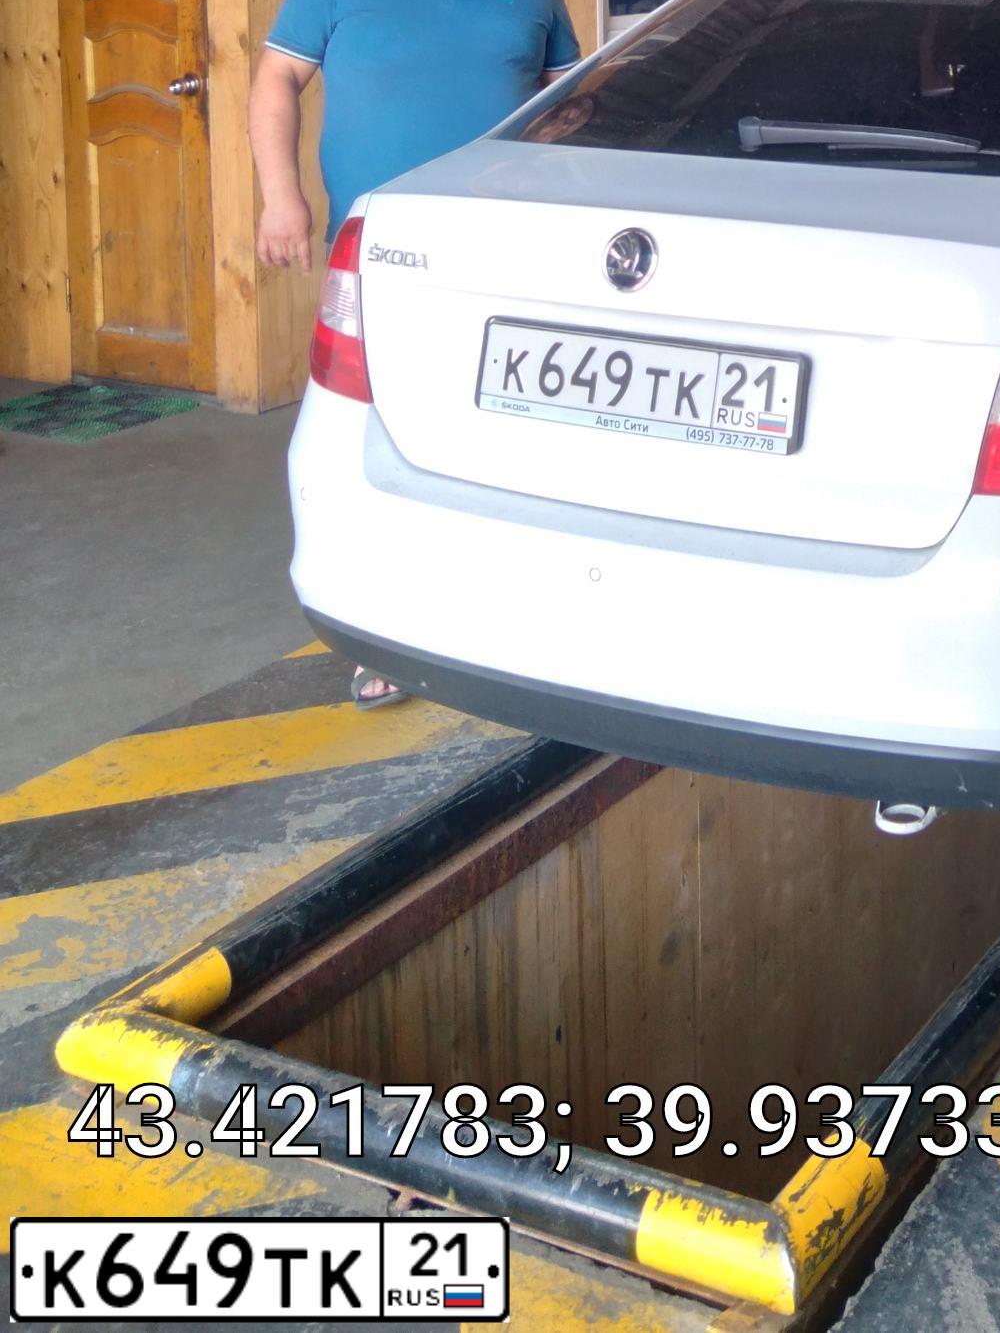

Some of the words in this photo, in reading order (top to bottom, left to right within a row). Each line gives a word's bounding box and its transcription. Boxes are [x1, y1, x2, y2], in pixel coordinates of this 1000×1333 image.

[720, 361, 777, 413] 21
[595, 415, 621, 429] Авто
[623, 418, 649, 433] Сити
[716, 407, 756, 428] RUS
[685, 426, 715, 444] (495)
[719, 432, 774, 451] 737-77-78
